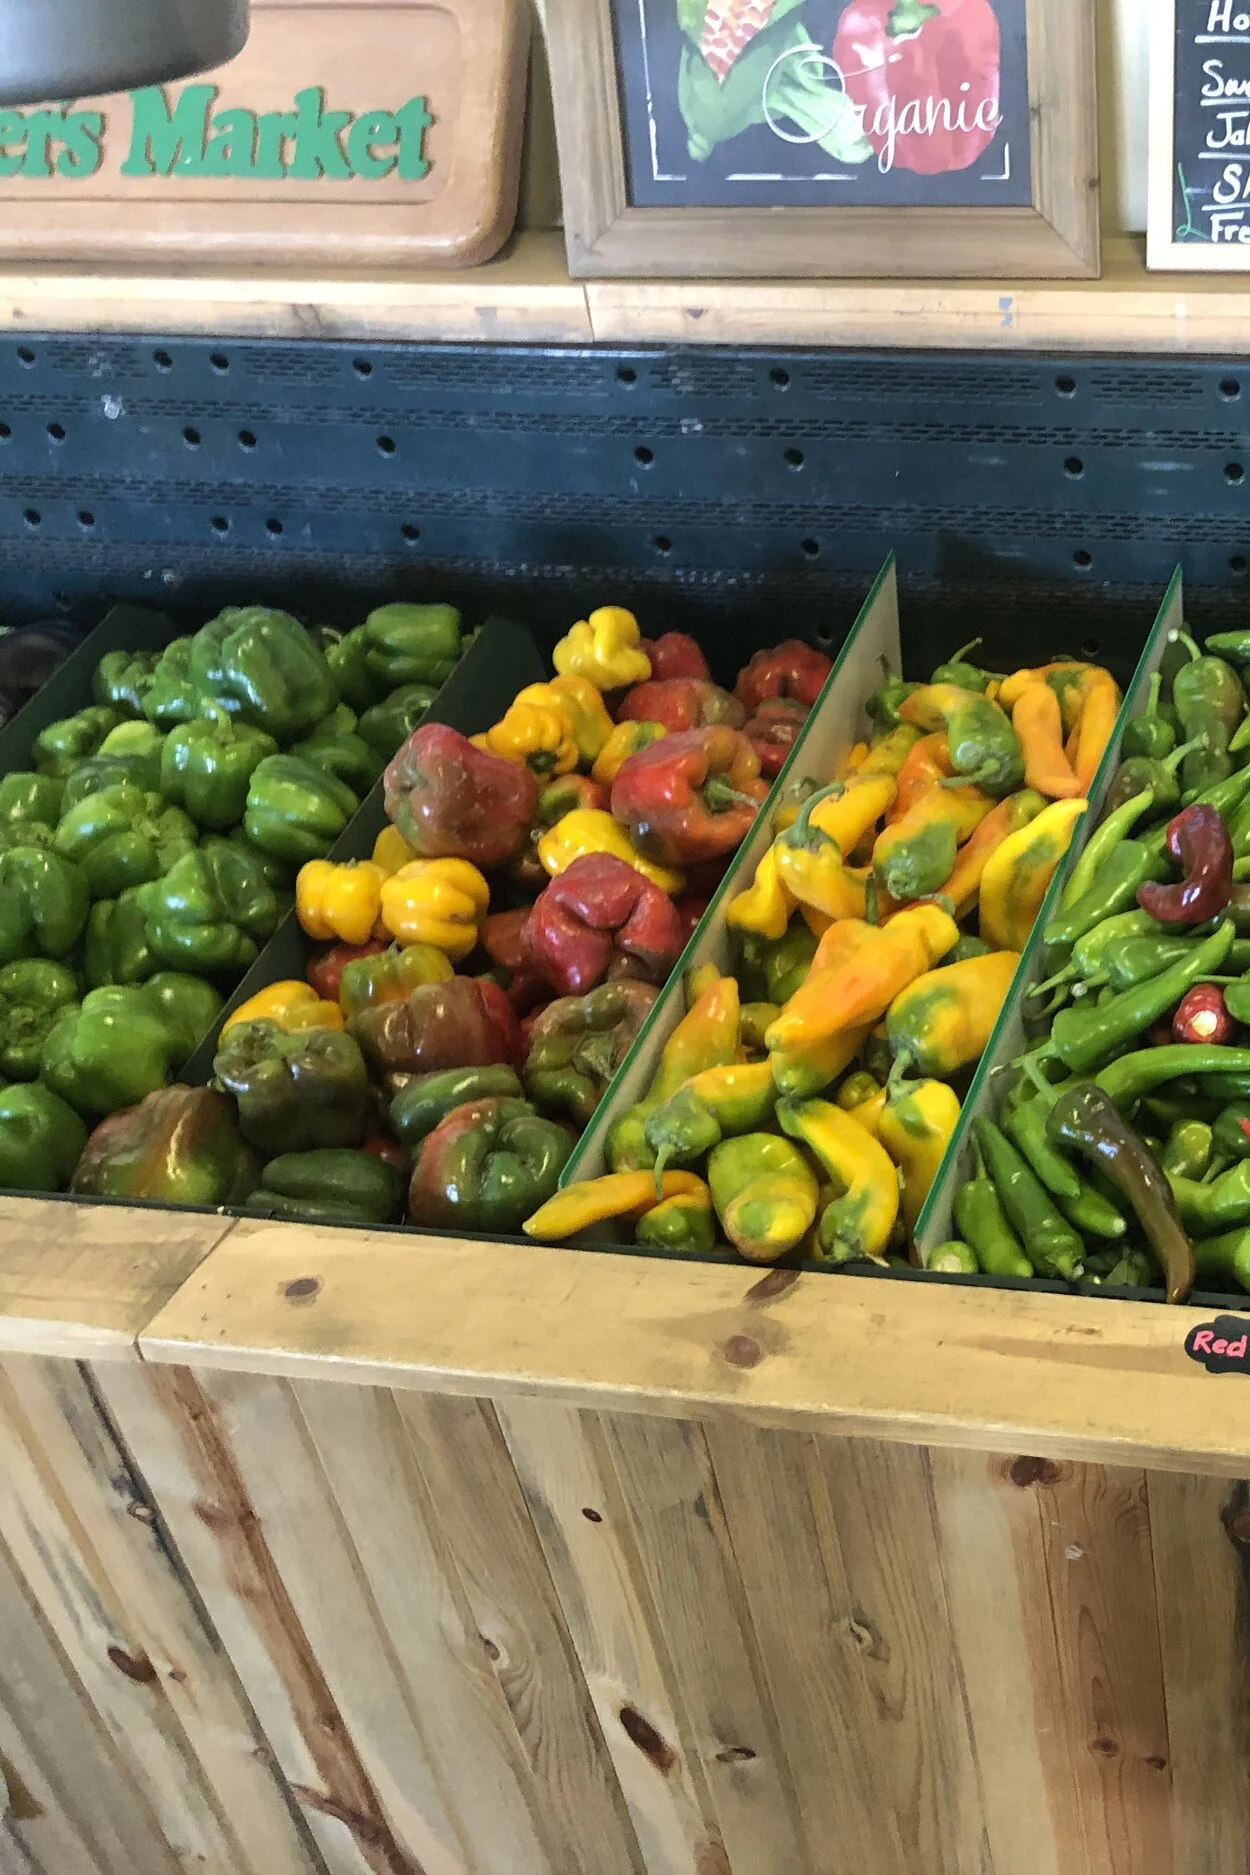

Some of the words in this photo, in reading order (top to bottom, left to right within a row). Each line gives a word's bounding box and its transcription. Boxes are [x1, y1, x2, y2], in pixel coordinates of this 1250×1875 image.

[119, 84, 437, 180] Market
[763, 44, 1004, 173] Organic
[1193, 1330, 1248, 1358] Red
